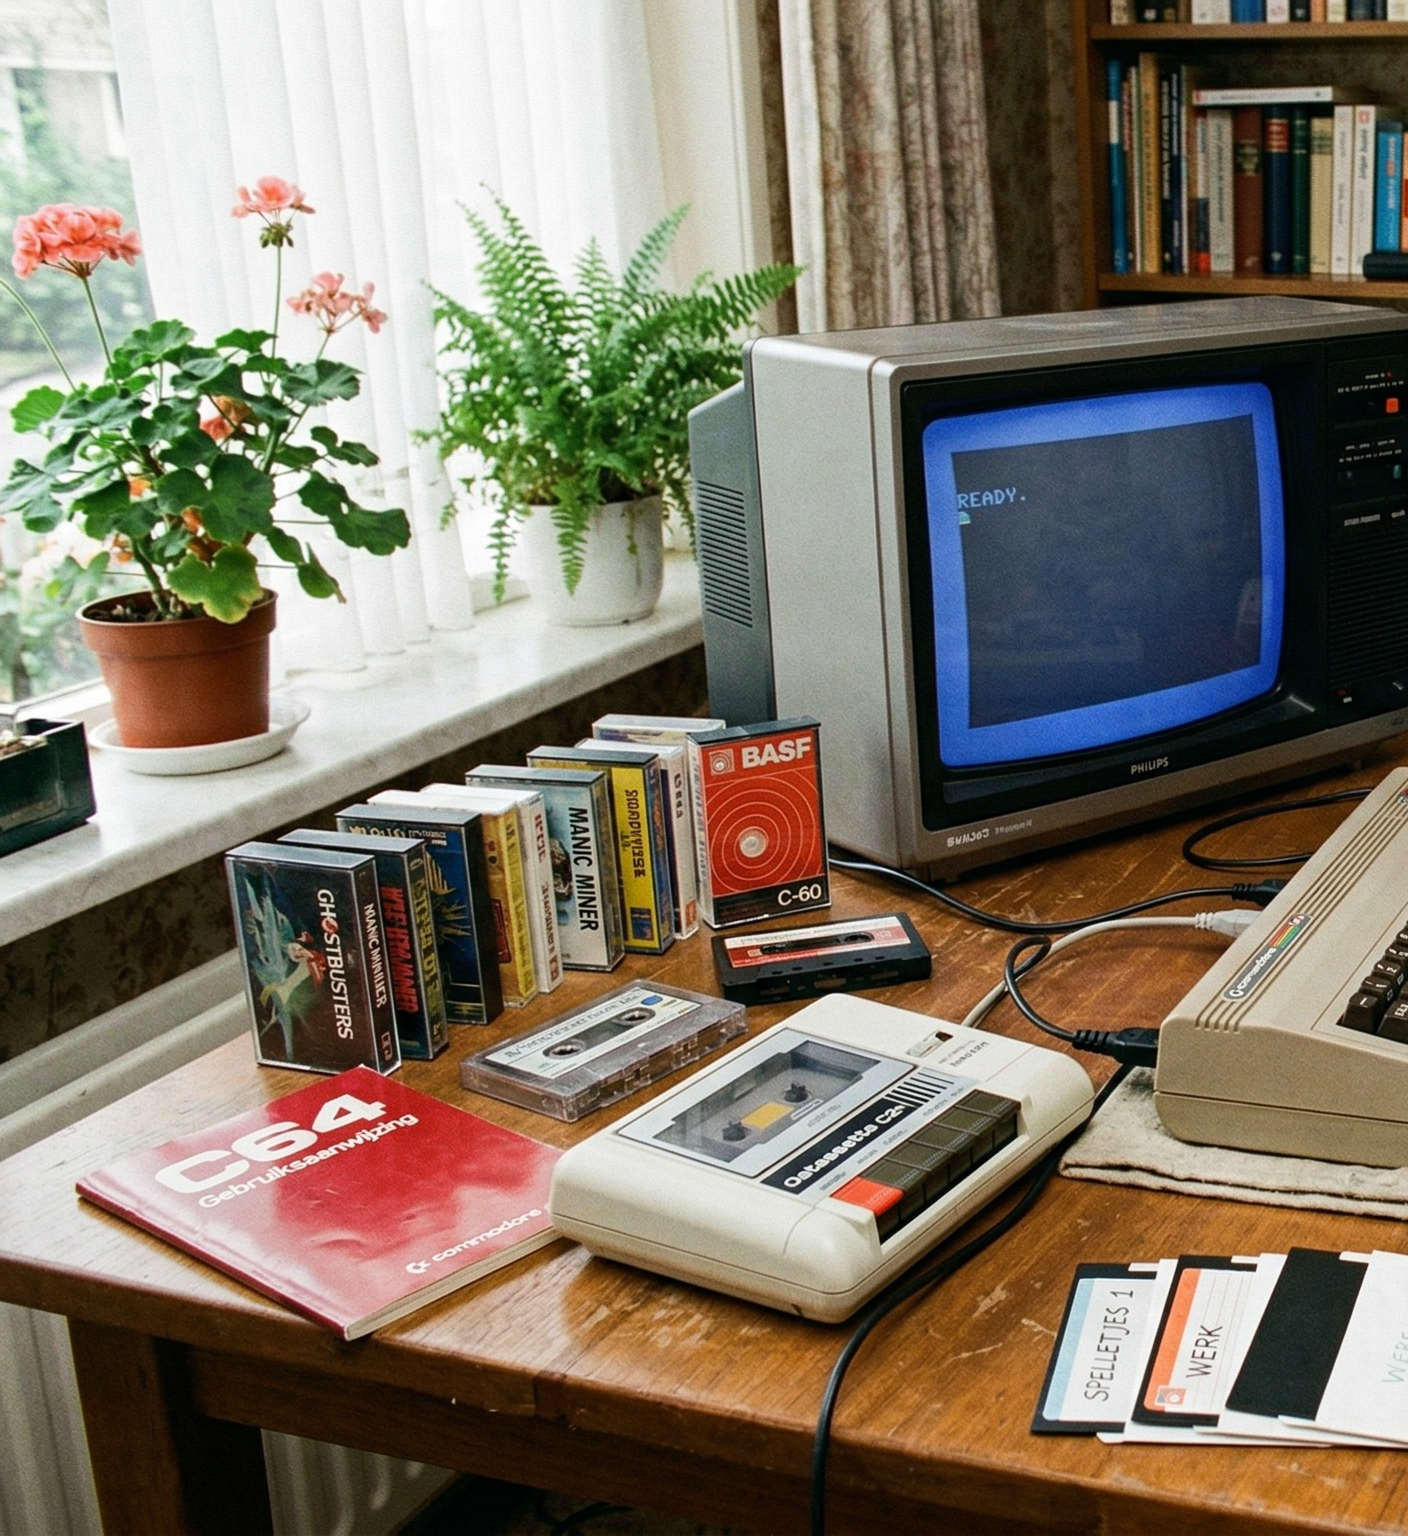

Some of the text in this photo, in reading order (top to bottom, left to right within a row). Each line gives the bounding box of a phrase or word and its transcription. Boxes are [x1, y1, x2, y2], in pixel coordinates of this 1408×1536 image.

[957, 487, 1026, 508] READY.
[741, 737, 812, 770] BASF
[1130, 757, 1169, 775] PHILIPS
[568, 807, 599, 931] MANIC MINER
[777, 883, 822, 907] C-60
[154, 1094, 387, 1193] C64
[197, 1111, 419, 1208] Gebruiksaanwijzing
[431, 1207, 541, 1263] commodore
[1084, 1306, 1131, 1402] SPELLETJES
[1186, 1324, 1223, 1378] WERK
